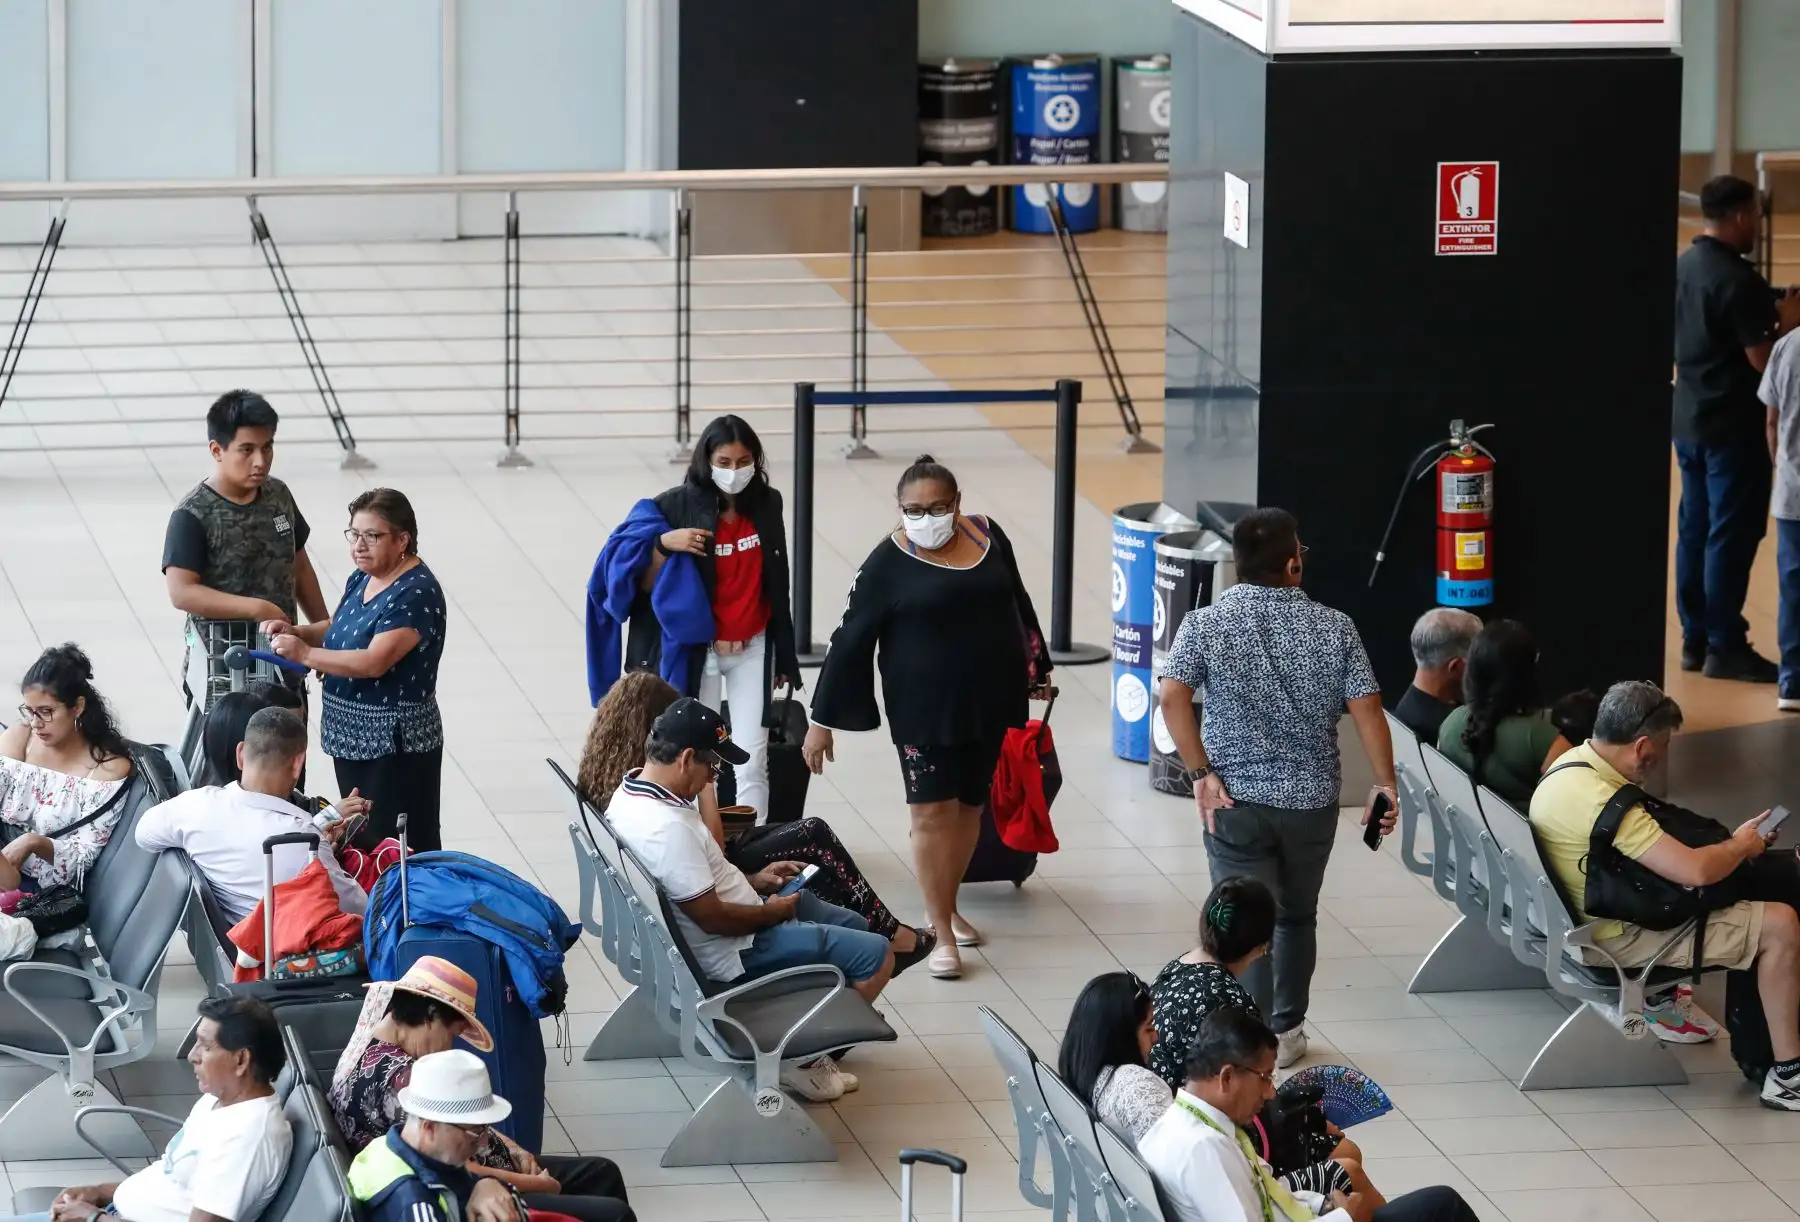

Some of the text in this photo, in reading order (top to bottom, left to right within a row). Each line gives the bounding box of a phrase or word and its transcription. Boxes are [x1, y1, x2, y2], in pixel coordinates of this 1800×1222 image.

[1466, 206, 1473, 217] 3
[1442, 224, 1491, 233] EXTINTOR
[1115, 624, 1141, 642] Cartón
[1116, 647, 1140, 664] Board
[1776, 1062, 1800, 1073] Donn
